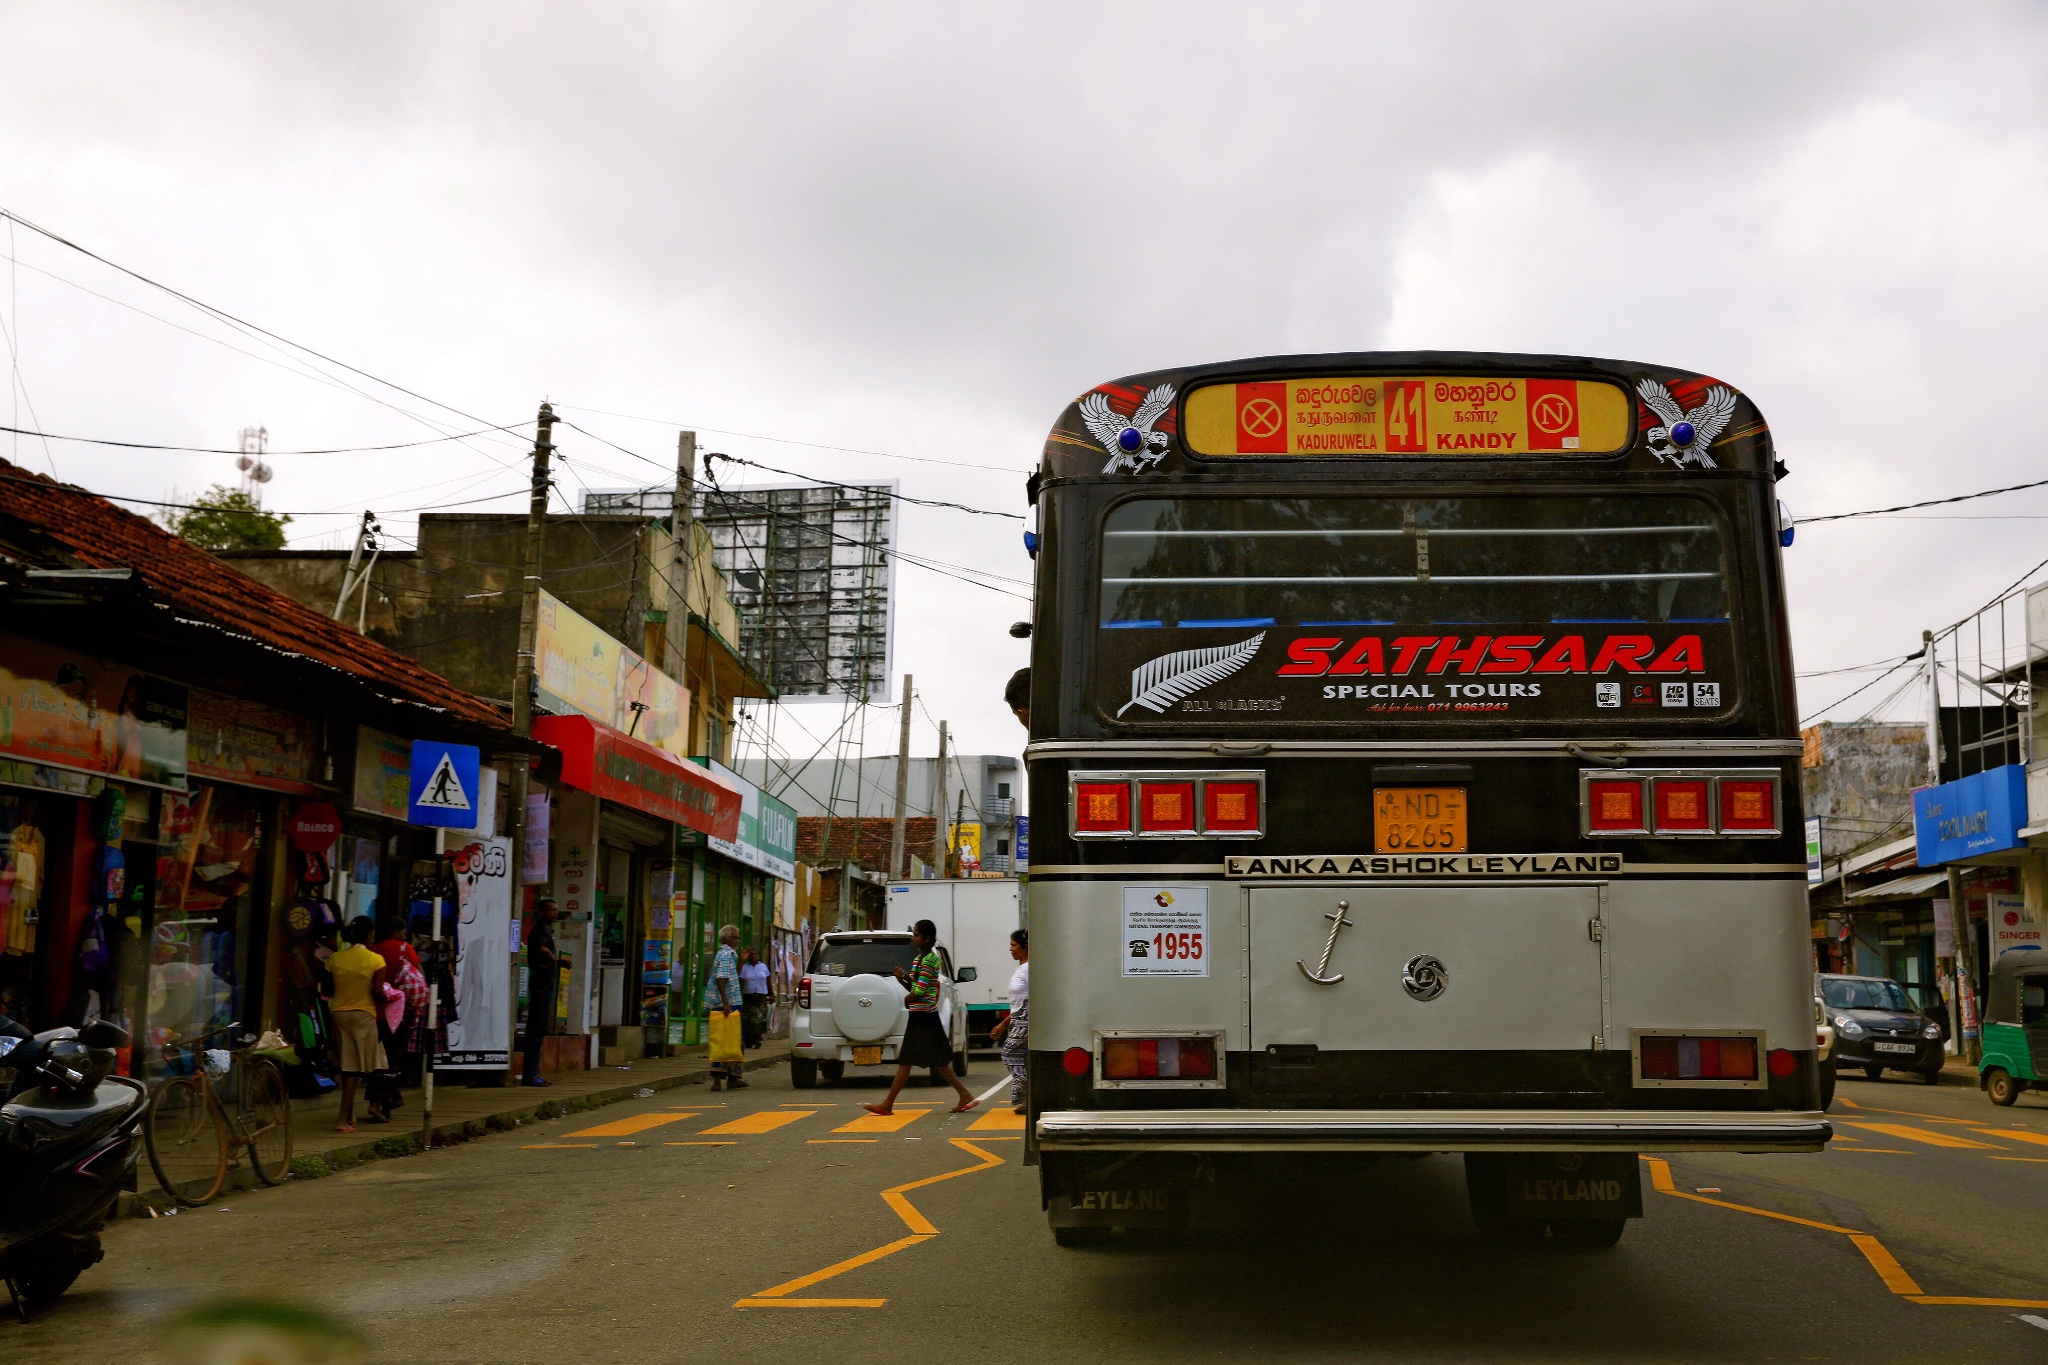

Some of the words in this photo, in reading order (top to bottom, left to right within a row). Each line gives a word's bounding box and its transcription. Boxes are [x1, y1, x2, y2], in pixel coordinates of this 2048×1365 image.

[1434, 381, 1517, 406] මහනුවර
[1389, 387, 1424, 446] 41
[1453, 406, 1499, 424] கண்டி
[1541, 402, 1566, 425] N
[1297, 433, 1378, 451] KADURUWELA
[1436, 432, 1518, 450] KANDY
[1276, 634, 1706, 678] SATHSARA
[1323, 684, 1436, 699] SPECIAL
[1445, 683, 1542, 698] TOURS
[1667, 686, 1684, 694] HD
[1697, 685, 1715, 697] 54
[1182, 700, 1213, 712] ALL
[1216, 699, 1283, 712] BLACKS
[1427, 702, 1450, 712] 071
[1453, 702, 1509, 712] 9963243
[1694, 698, 1719, 706] SEATS
[1405, 793, 1440, 820] ND
[762, 806, 795, 854] FUJIFILM
[1387, 822, 1455, 849] 8265
[1228, 857, 1339, 875] LANKA
[1347, 857, 1459, 874] ASHOK
[1467, 856, 1620, 873] LEYLAND
[1998, 931, 2041, 940] SINGER
[1153, 932, 1203, 960] 1955
[1522, 1179, 1621, 1201] LEYLAND
